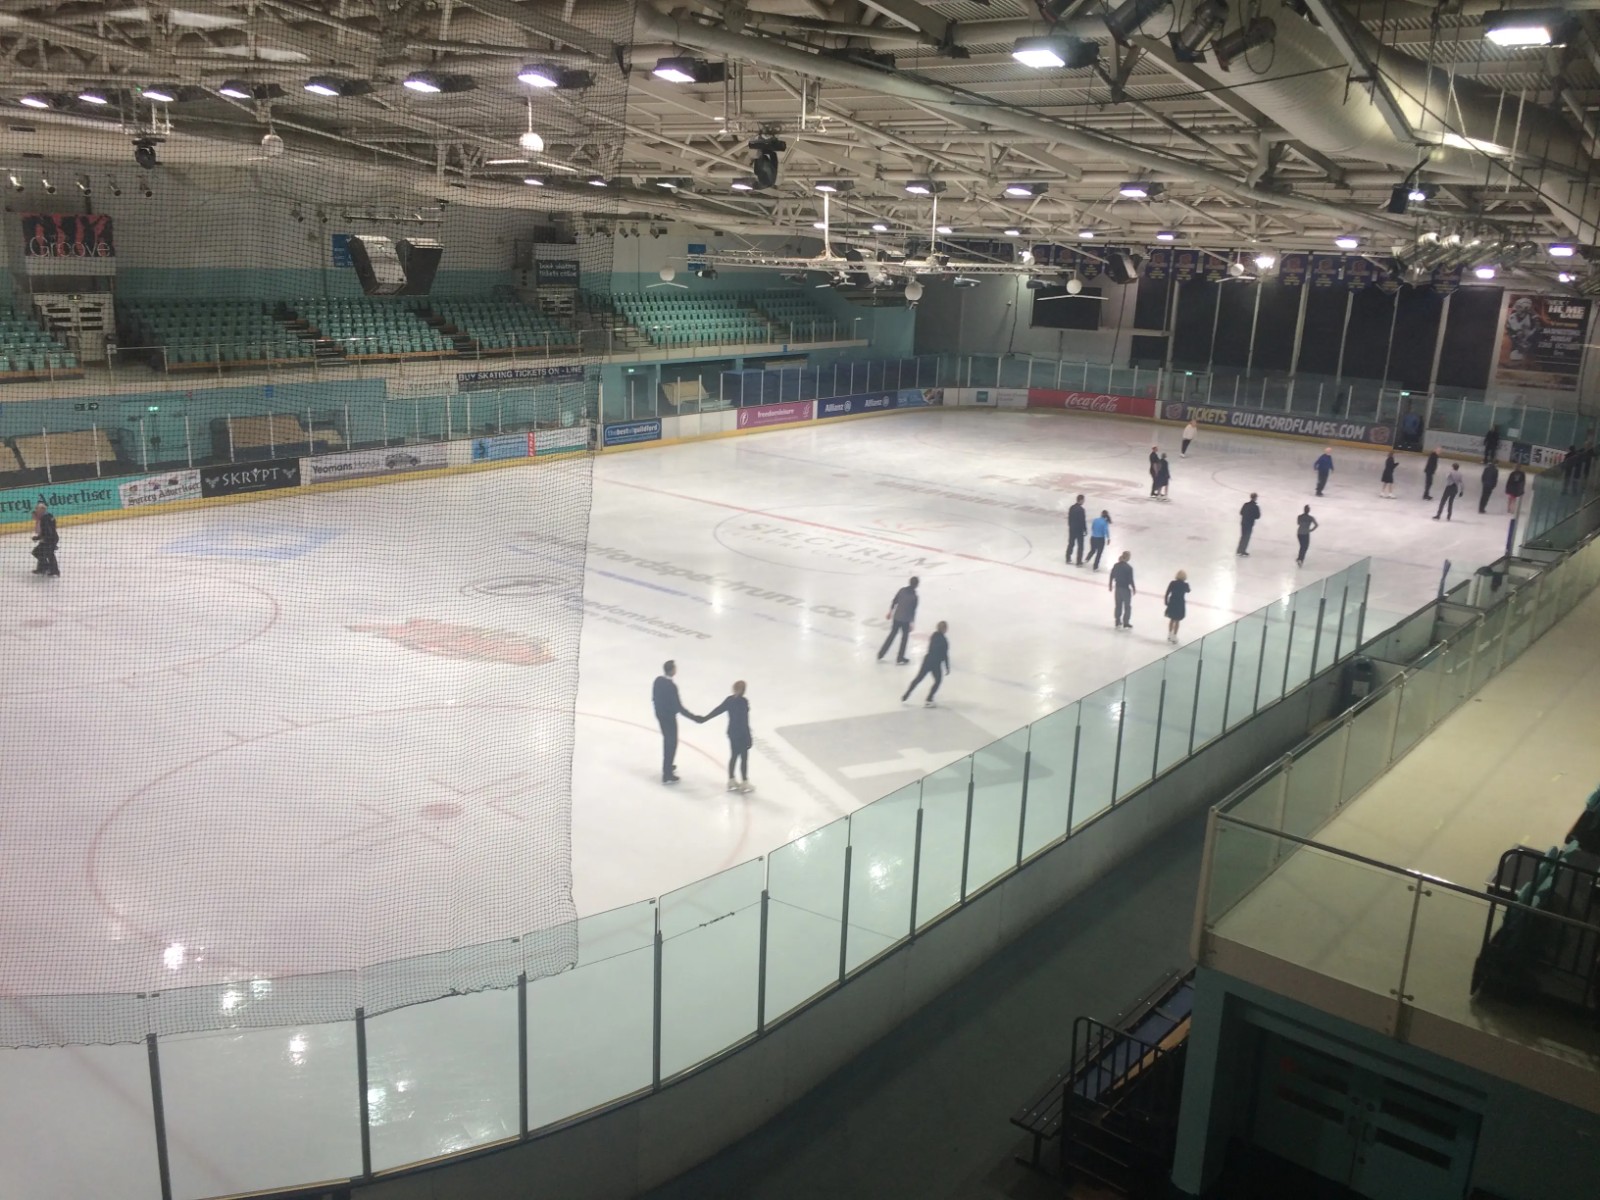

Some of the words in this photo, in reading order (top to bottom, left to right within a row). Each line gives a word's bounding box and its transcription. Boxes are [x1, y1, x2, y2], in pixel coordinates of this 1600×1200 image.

[29, 235, 111, 257] Groove
[458, 373, 476, 382] BUY
[477, 370, 513, 380] SKATING
[515, 368, 546, 378] TICKETS
[1186, 406, 1228, 423] TICKETS
[1231, 411, 1366, 440] GUILDFORDFLAMES.COM
[222, 467, 280, 486] SKRYPT
[313, 463, 353, 474] Yeomans
[740, 522, 949, 570] SPECTRUM
